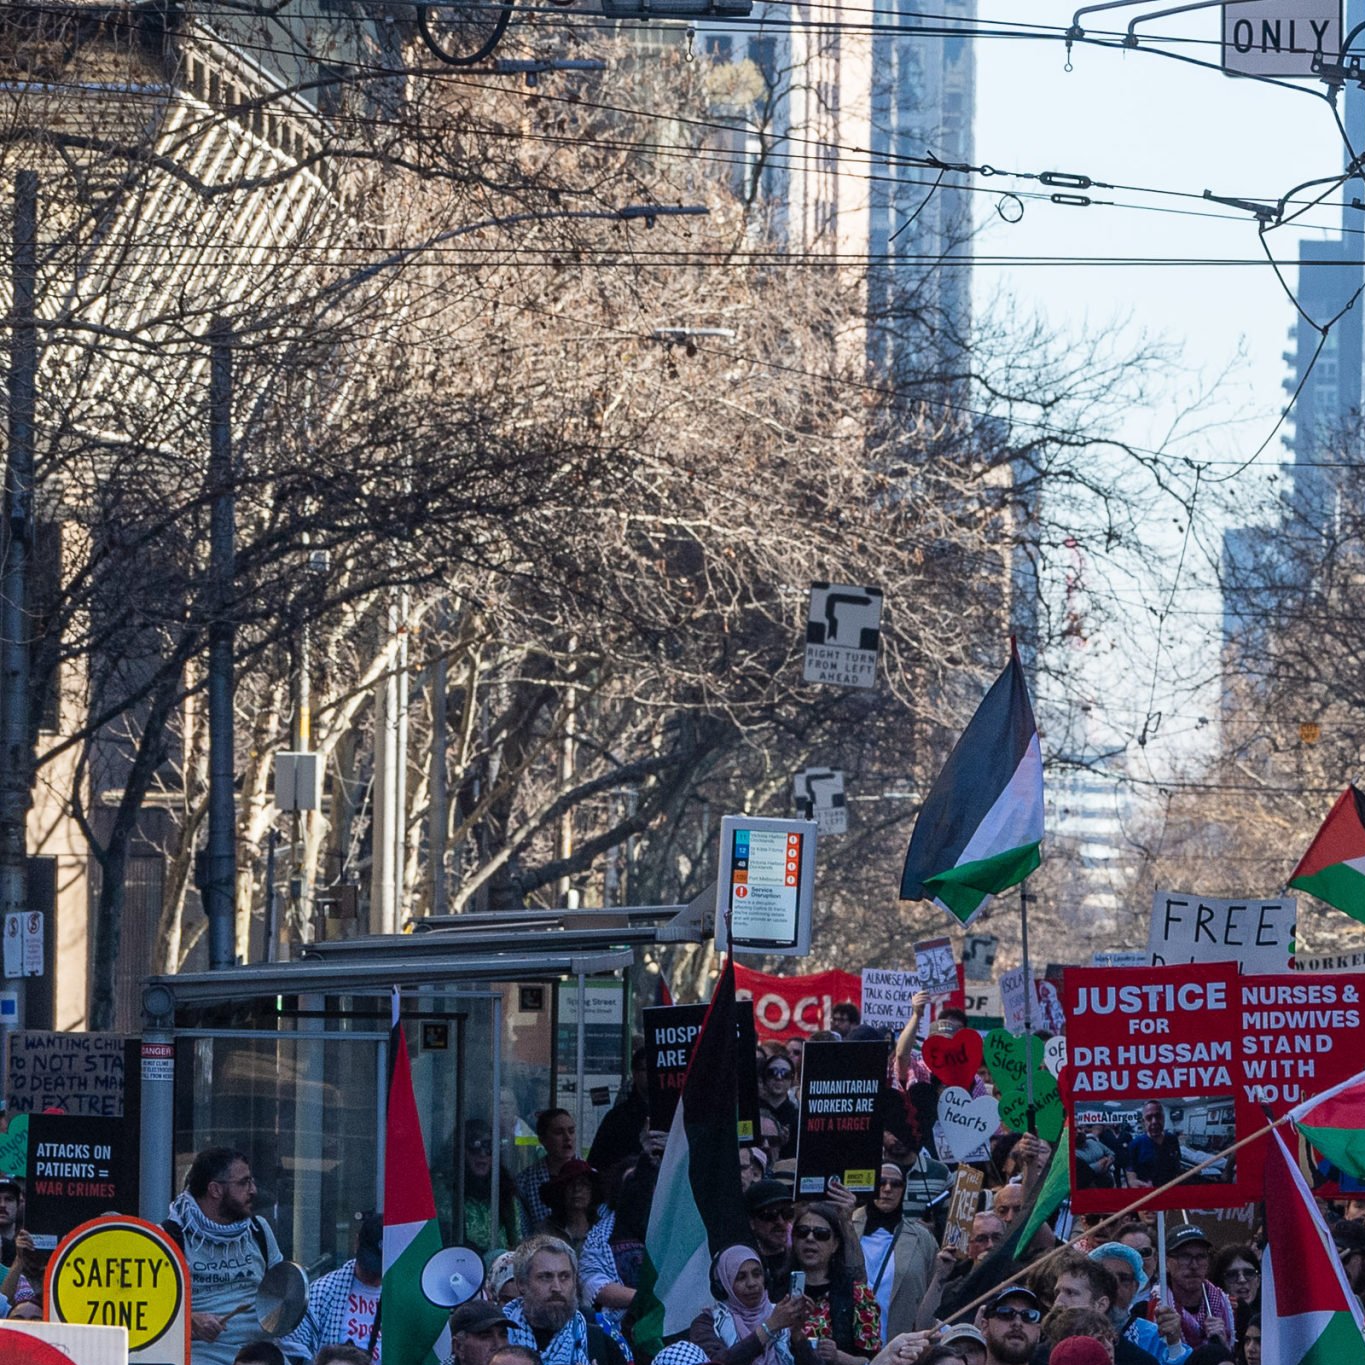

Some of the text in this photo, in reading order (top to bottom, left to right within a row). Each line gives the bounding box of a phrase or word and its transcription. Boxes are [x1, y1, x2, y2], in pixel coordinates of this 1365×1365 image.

[1234, 19, 1330, 54] ONLY
[808, 648, 876, 664] RIGHT TURN
[808, 659, 872, 674] FROM LEFT
[819, 671, 859, 684] AHEAD
[1164, 899, 1282, 946] FREE
[864, 988, 883, 1001] TALK
[1073, 982, 1227, 1015] JUSTICE
[1242, 984, 1359, 1005] NURSES &
[1129, 1019, 1169, 1034] FOR
[1242, 1010, 1360, 1029] MIDWIVES
[25, 1035, 91, 1050] WANTING
[1242, 1035, 1333, 1054] STAND
[656, 1050, 687, 1067] ARE
[931, 1044, 968, 1069] End
[1074, 1041, 1231, 1067] DR HUSSAM
[33, 1055, 80, 1072] NOT
[1242, 1059, 1315, 1078] WITH
[31, 1075, 88, 1091] DEATH
[809, 1080, 879, 1095] HUMANITARIAN
[1073, 1067, 1231, 1092] ABU SAFIYA
[945, 1091, 972, 1107] Our
[1244, 1084, 1300, 1103] YOU
[808, 1098, 874, 1113] WORKERS ARE
[808, 1117, 871, 1132] NOT A TARGET
[945, 1107, 988, 1132] hearts
[1078, 1110, 1139, 1124] #NotATarget
[36, 1143, 111, 1160] ATTACKS ON
[36, 1162, 95, 1178] PATIENTS
[35, 1181, 115, 1198] WAR CRIMES
[193, 1255, 253, 1272] ORACLE
[72, 1257, 164, 1289] SAFETY
[87, 1301, 148, 1331] ZONE
